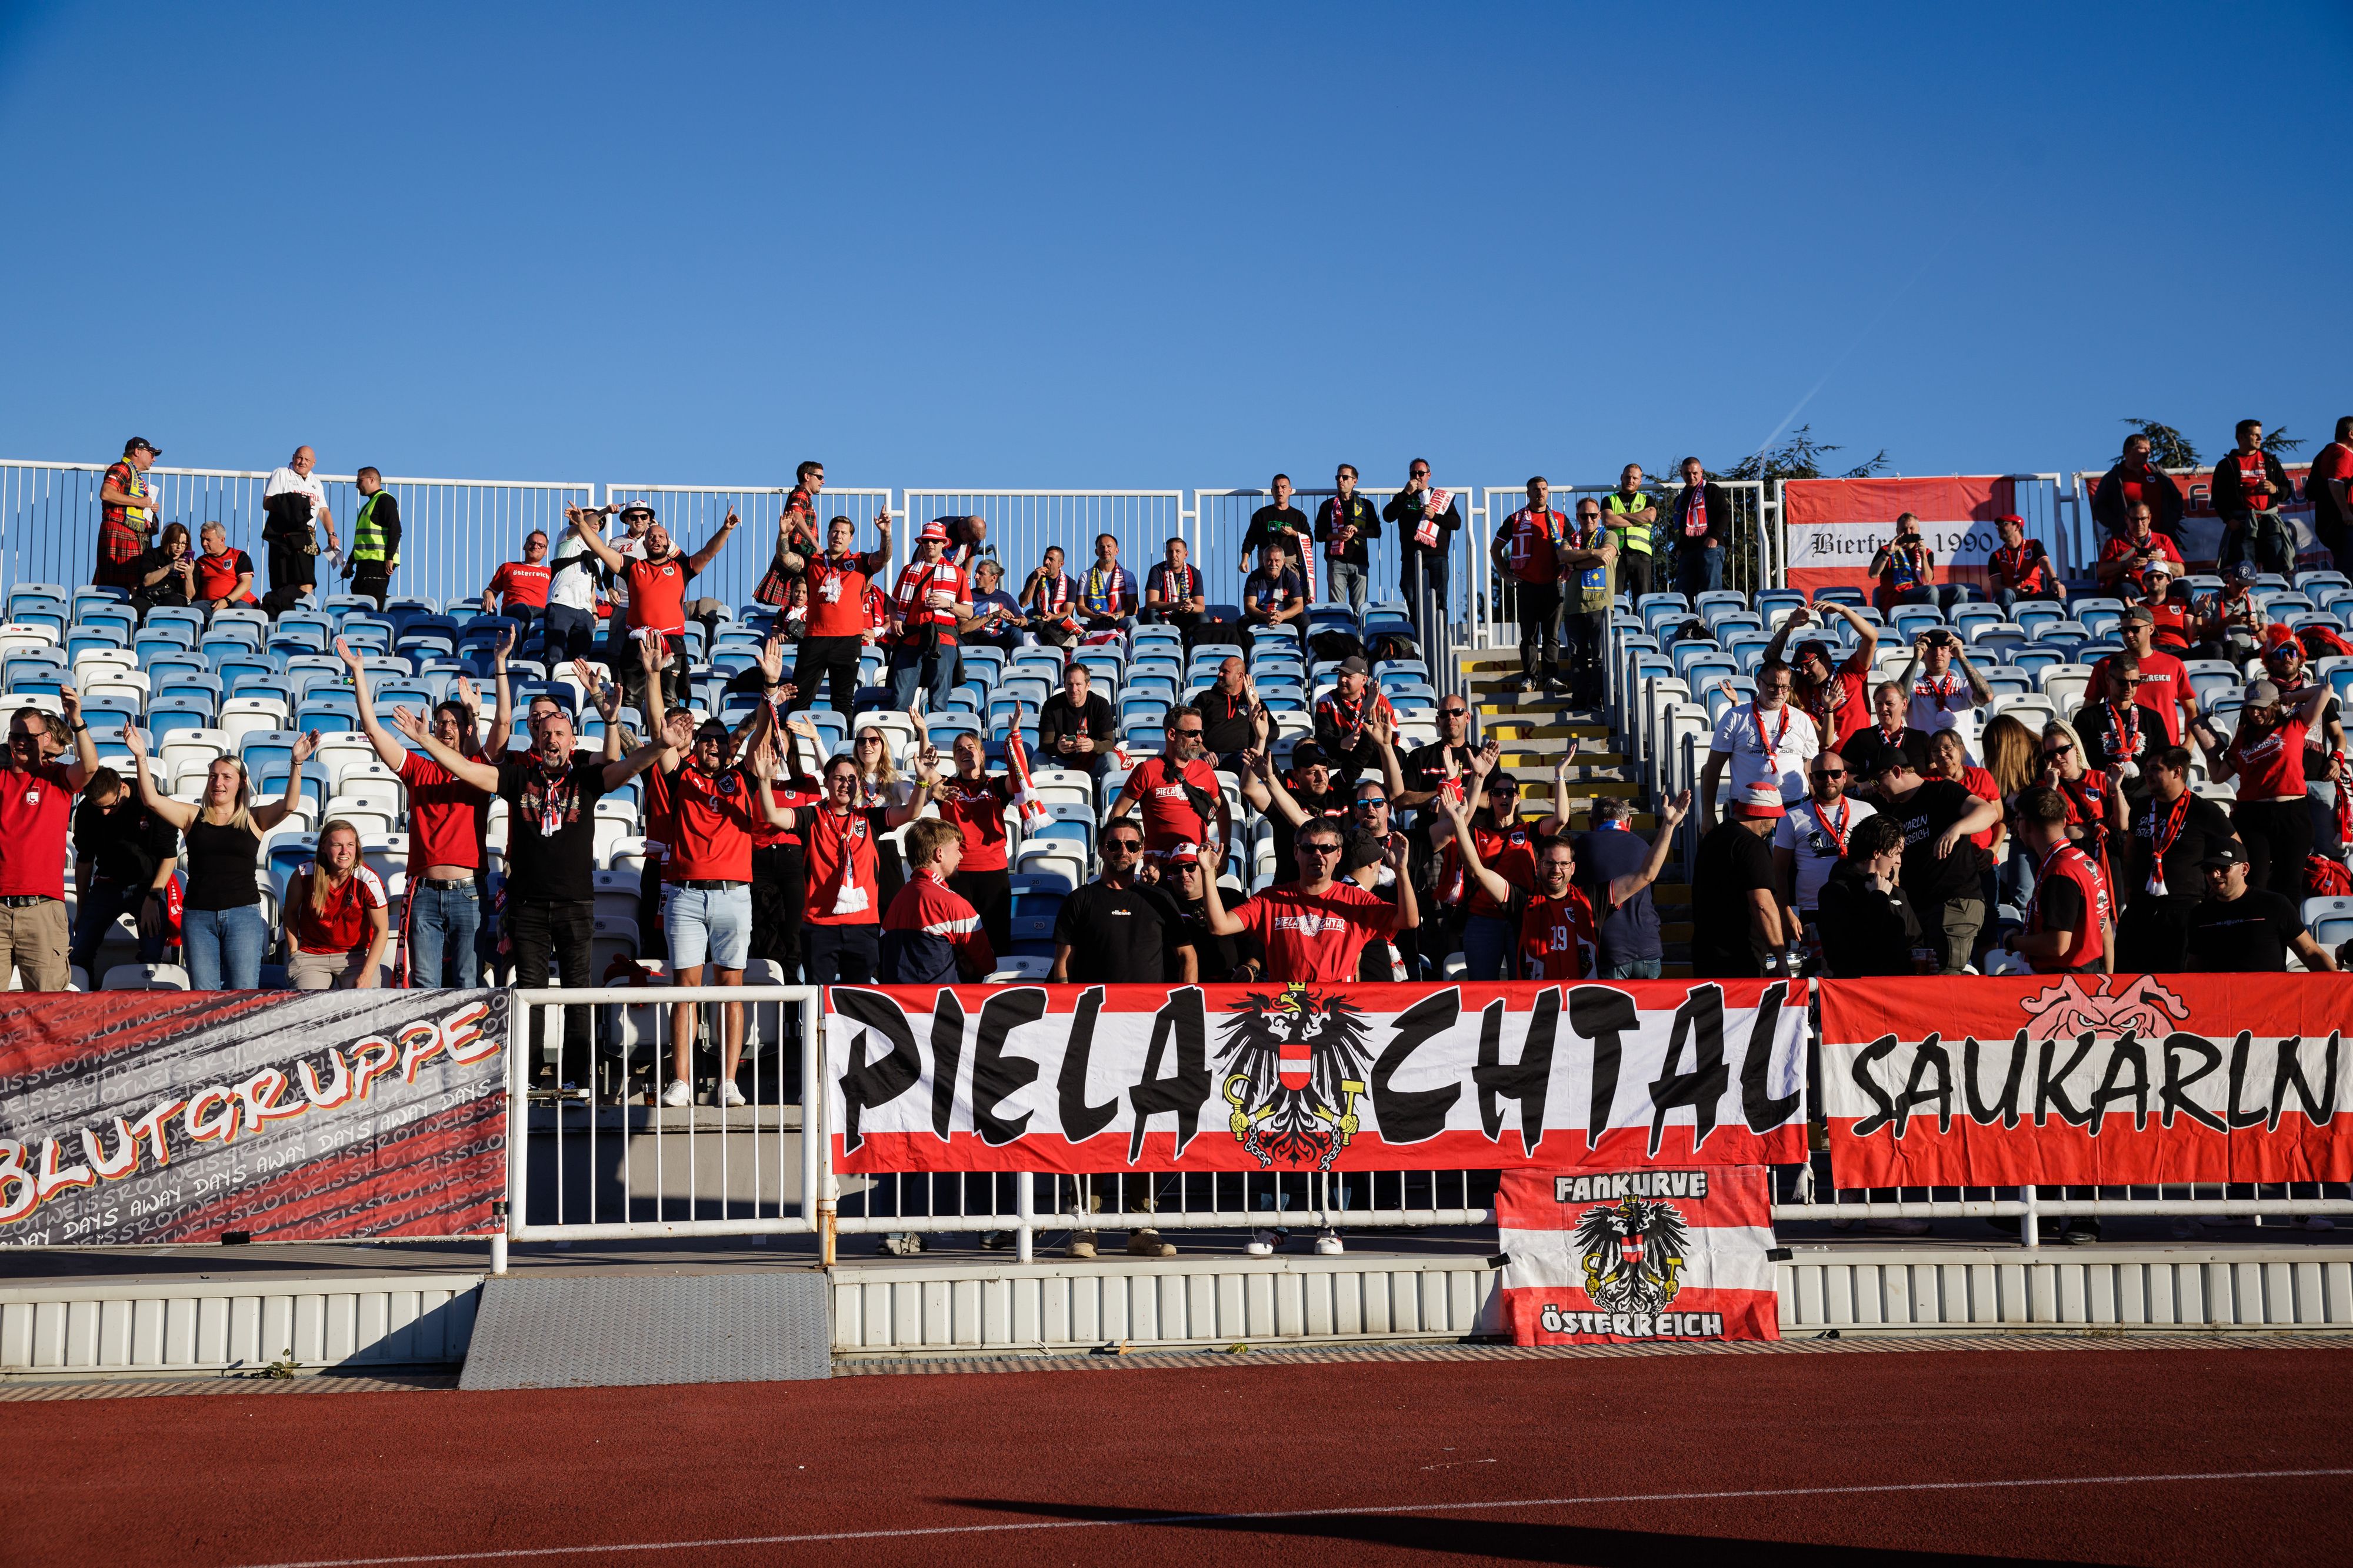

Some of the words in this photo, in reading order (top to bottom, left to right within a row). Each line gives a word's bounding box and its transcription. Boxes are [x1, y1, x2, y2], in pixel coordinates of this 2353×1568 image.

[619, 543, 633, 553] 22
[1935, 533, 1993, 553] 1990
[513, 569, 549, 580] österreich
[1493, 661, 1506, 670] N
[2148, 674, 2171, 682] REICH
[1502, 684, 1515, 692] M
[1522, 728, 1534, 739] K
[708, 795, 718, 812] 4
[1905, 828, 1929, 846] RREICH
[1275, 918, 1299, 928] PIELA
[1551, 926, 1568, 951] 19
[1851, 1027, 2340, 1140] SAUKARLN
[0, 1001, 501, 1225] BLUTGRUPPE
[64, 1207, 118, 1240] DAYS
[131, 1186, 181, 1217] AWAY
[194, 1165, 247, 1196] DAYS
[256, 1142, 306, 1173] AWAY
[318, 1120, 371, 1153] DAYS
[380, 1101, 428, 1130] AWAY
[440, 1079, 491, 1111] DAYS
[1555, 1172, 1708, 1202] FANKURVE
[1542, 1304, 1724, 1338] ÖSTERREICH
